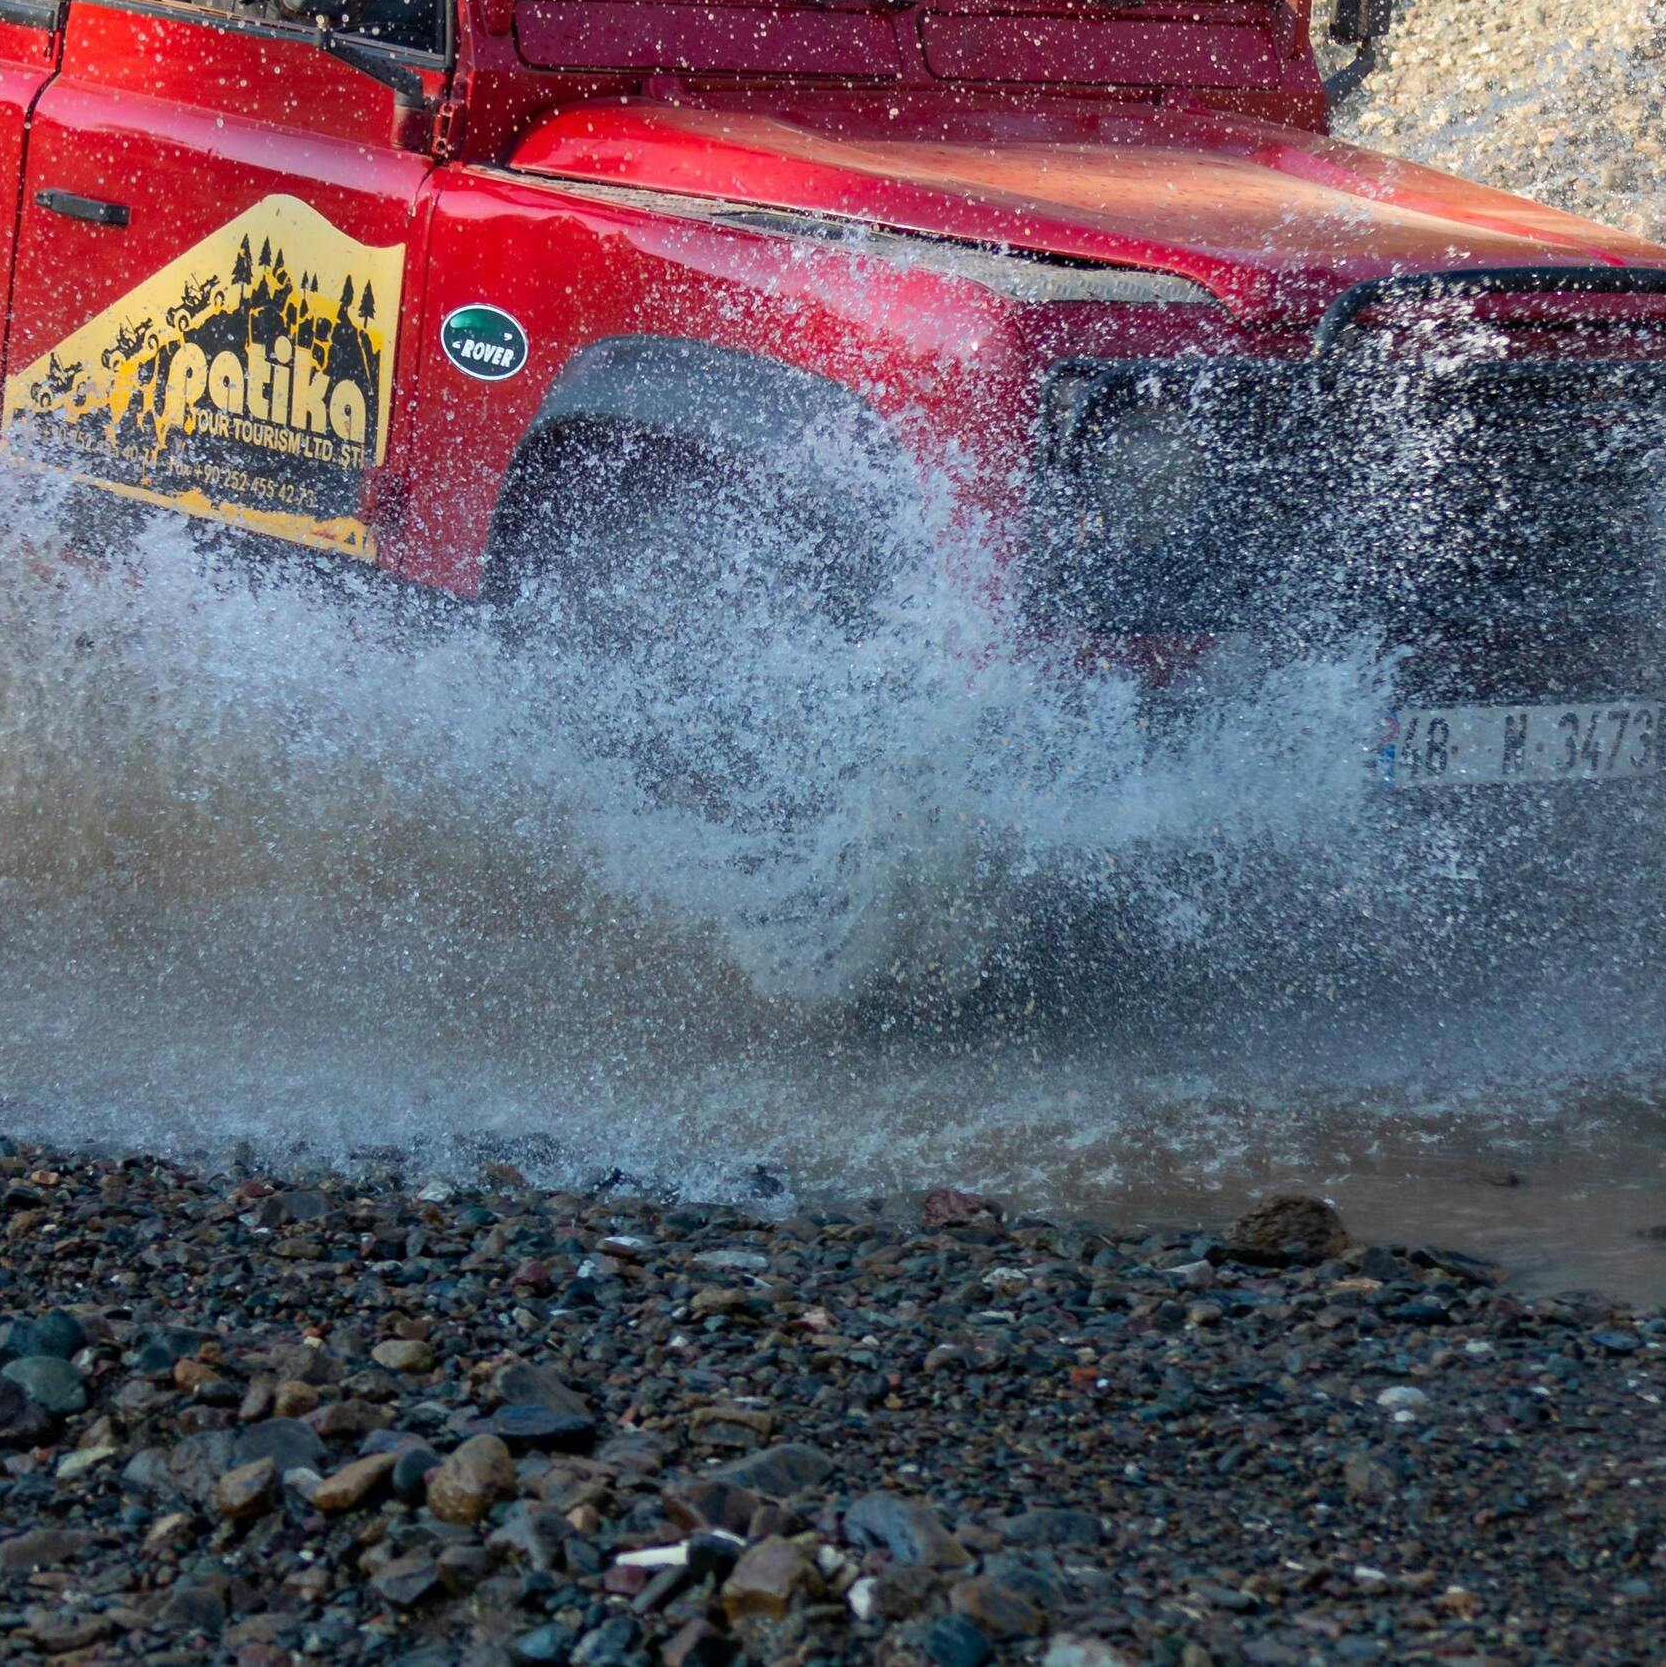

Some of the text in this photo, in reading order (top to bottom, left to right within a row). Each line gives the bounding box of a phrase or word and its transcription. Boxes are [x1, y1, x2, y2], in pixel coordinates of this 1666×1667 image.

[460, 338, 515, 368] ROVER
[162, 336, 367, 444] patika
[190, 406, 230, 437] TOUR
[233, 418, 301, 455] TOURISM
[224, 466, 247, 492] 252
[251, 476, 275, 500] 455
[278, 483, 294, 504] 42
[1555, 709, 1654, 774] 3473
